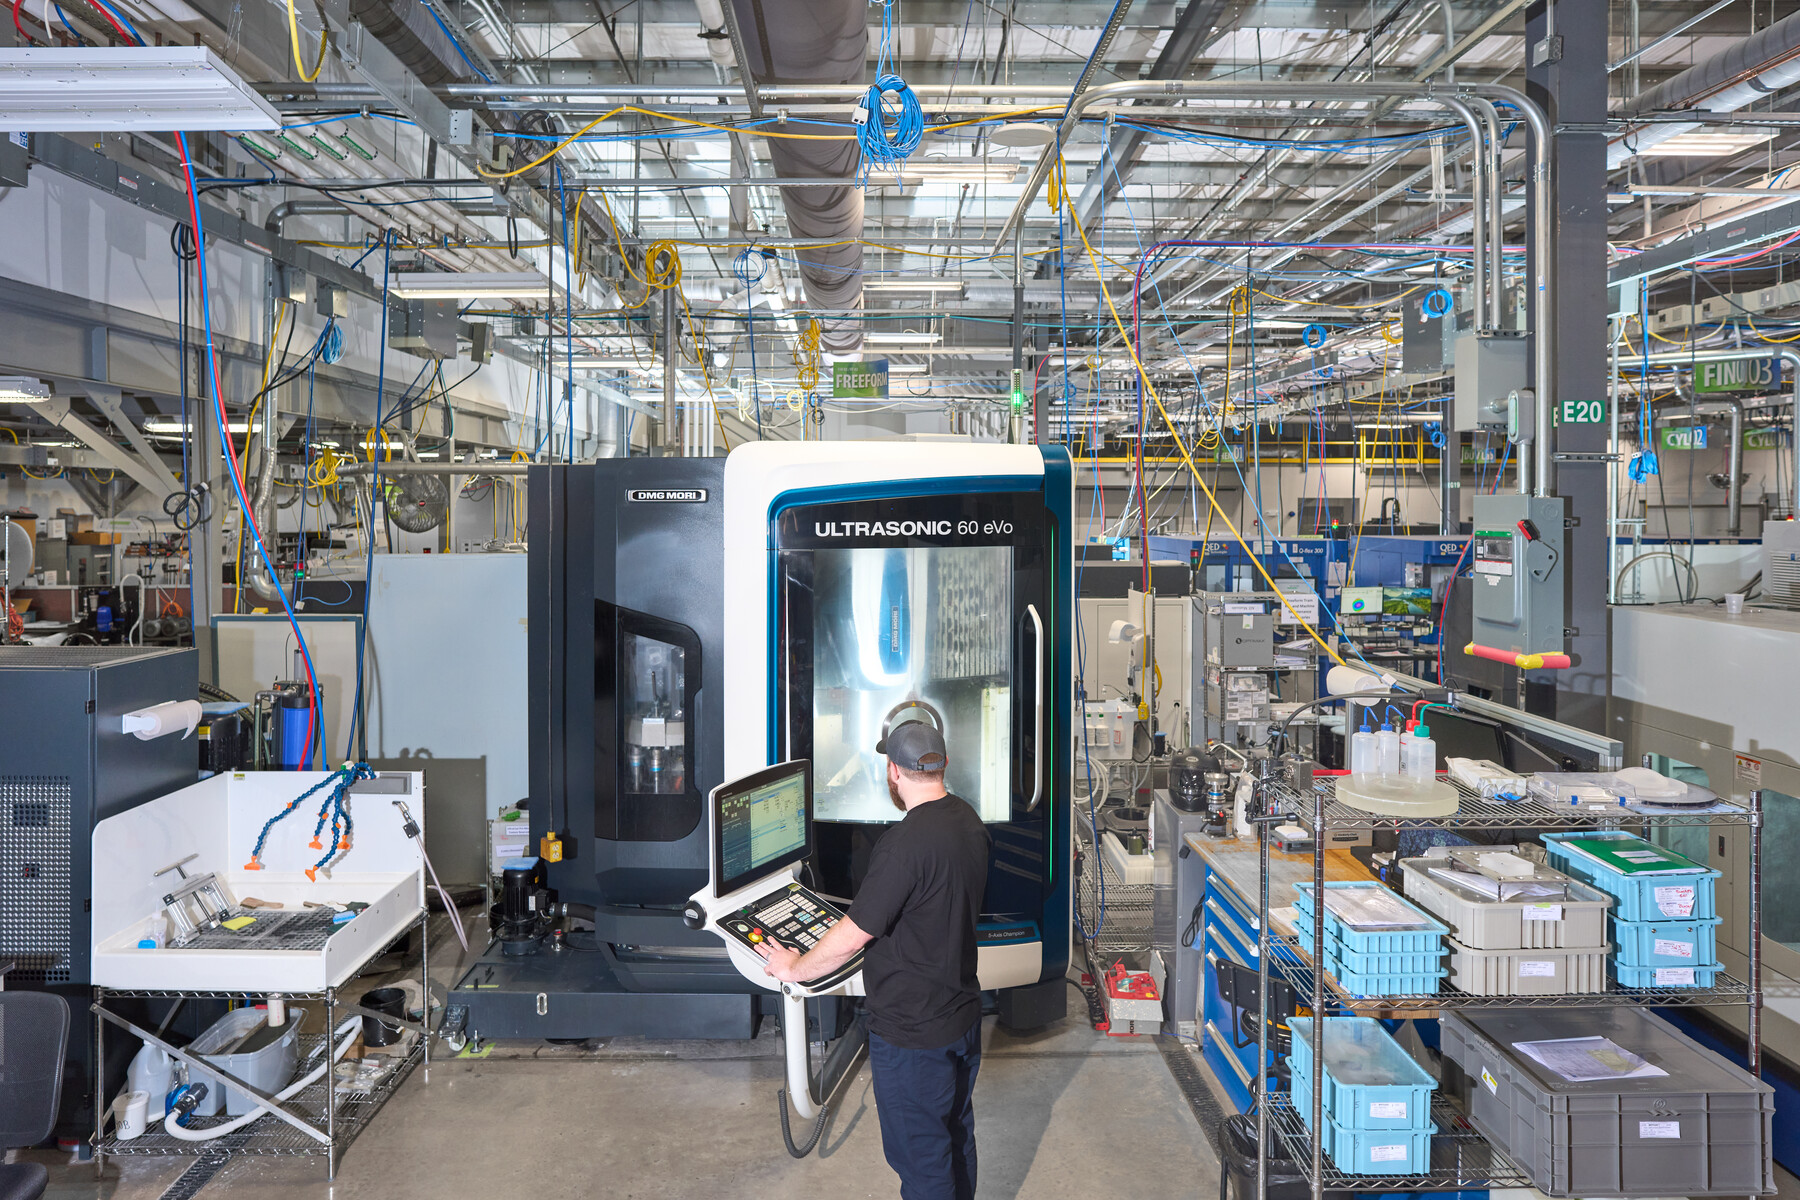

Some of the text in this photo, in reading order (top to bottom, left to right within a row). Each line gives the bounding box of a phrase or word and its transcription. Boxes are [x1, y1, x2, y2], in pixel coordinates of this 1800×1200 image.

[836, 371, 888, 389] FREEFORM
[1564, 401, 1602, 423] E20
[638, 492, 697, 500] DMG MORI
[815, 520, 1014, 537] ULTRASONIC 60 eVo
[1440, 543, 1457, 552] QED
